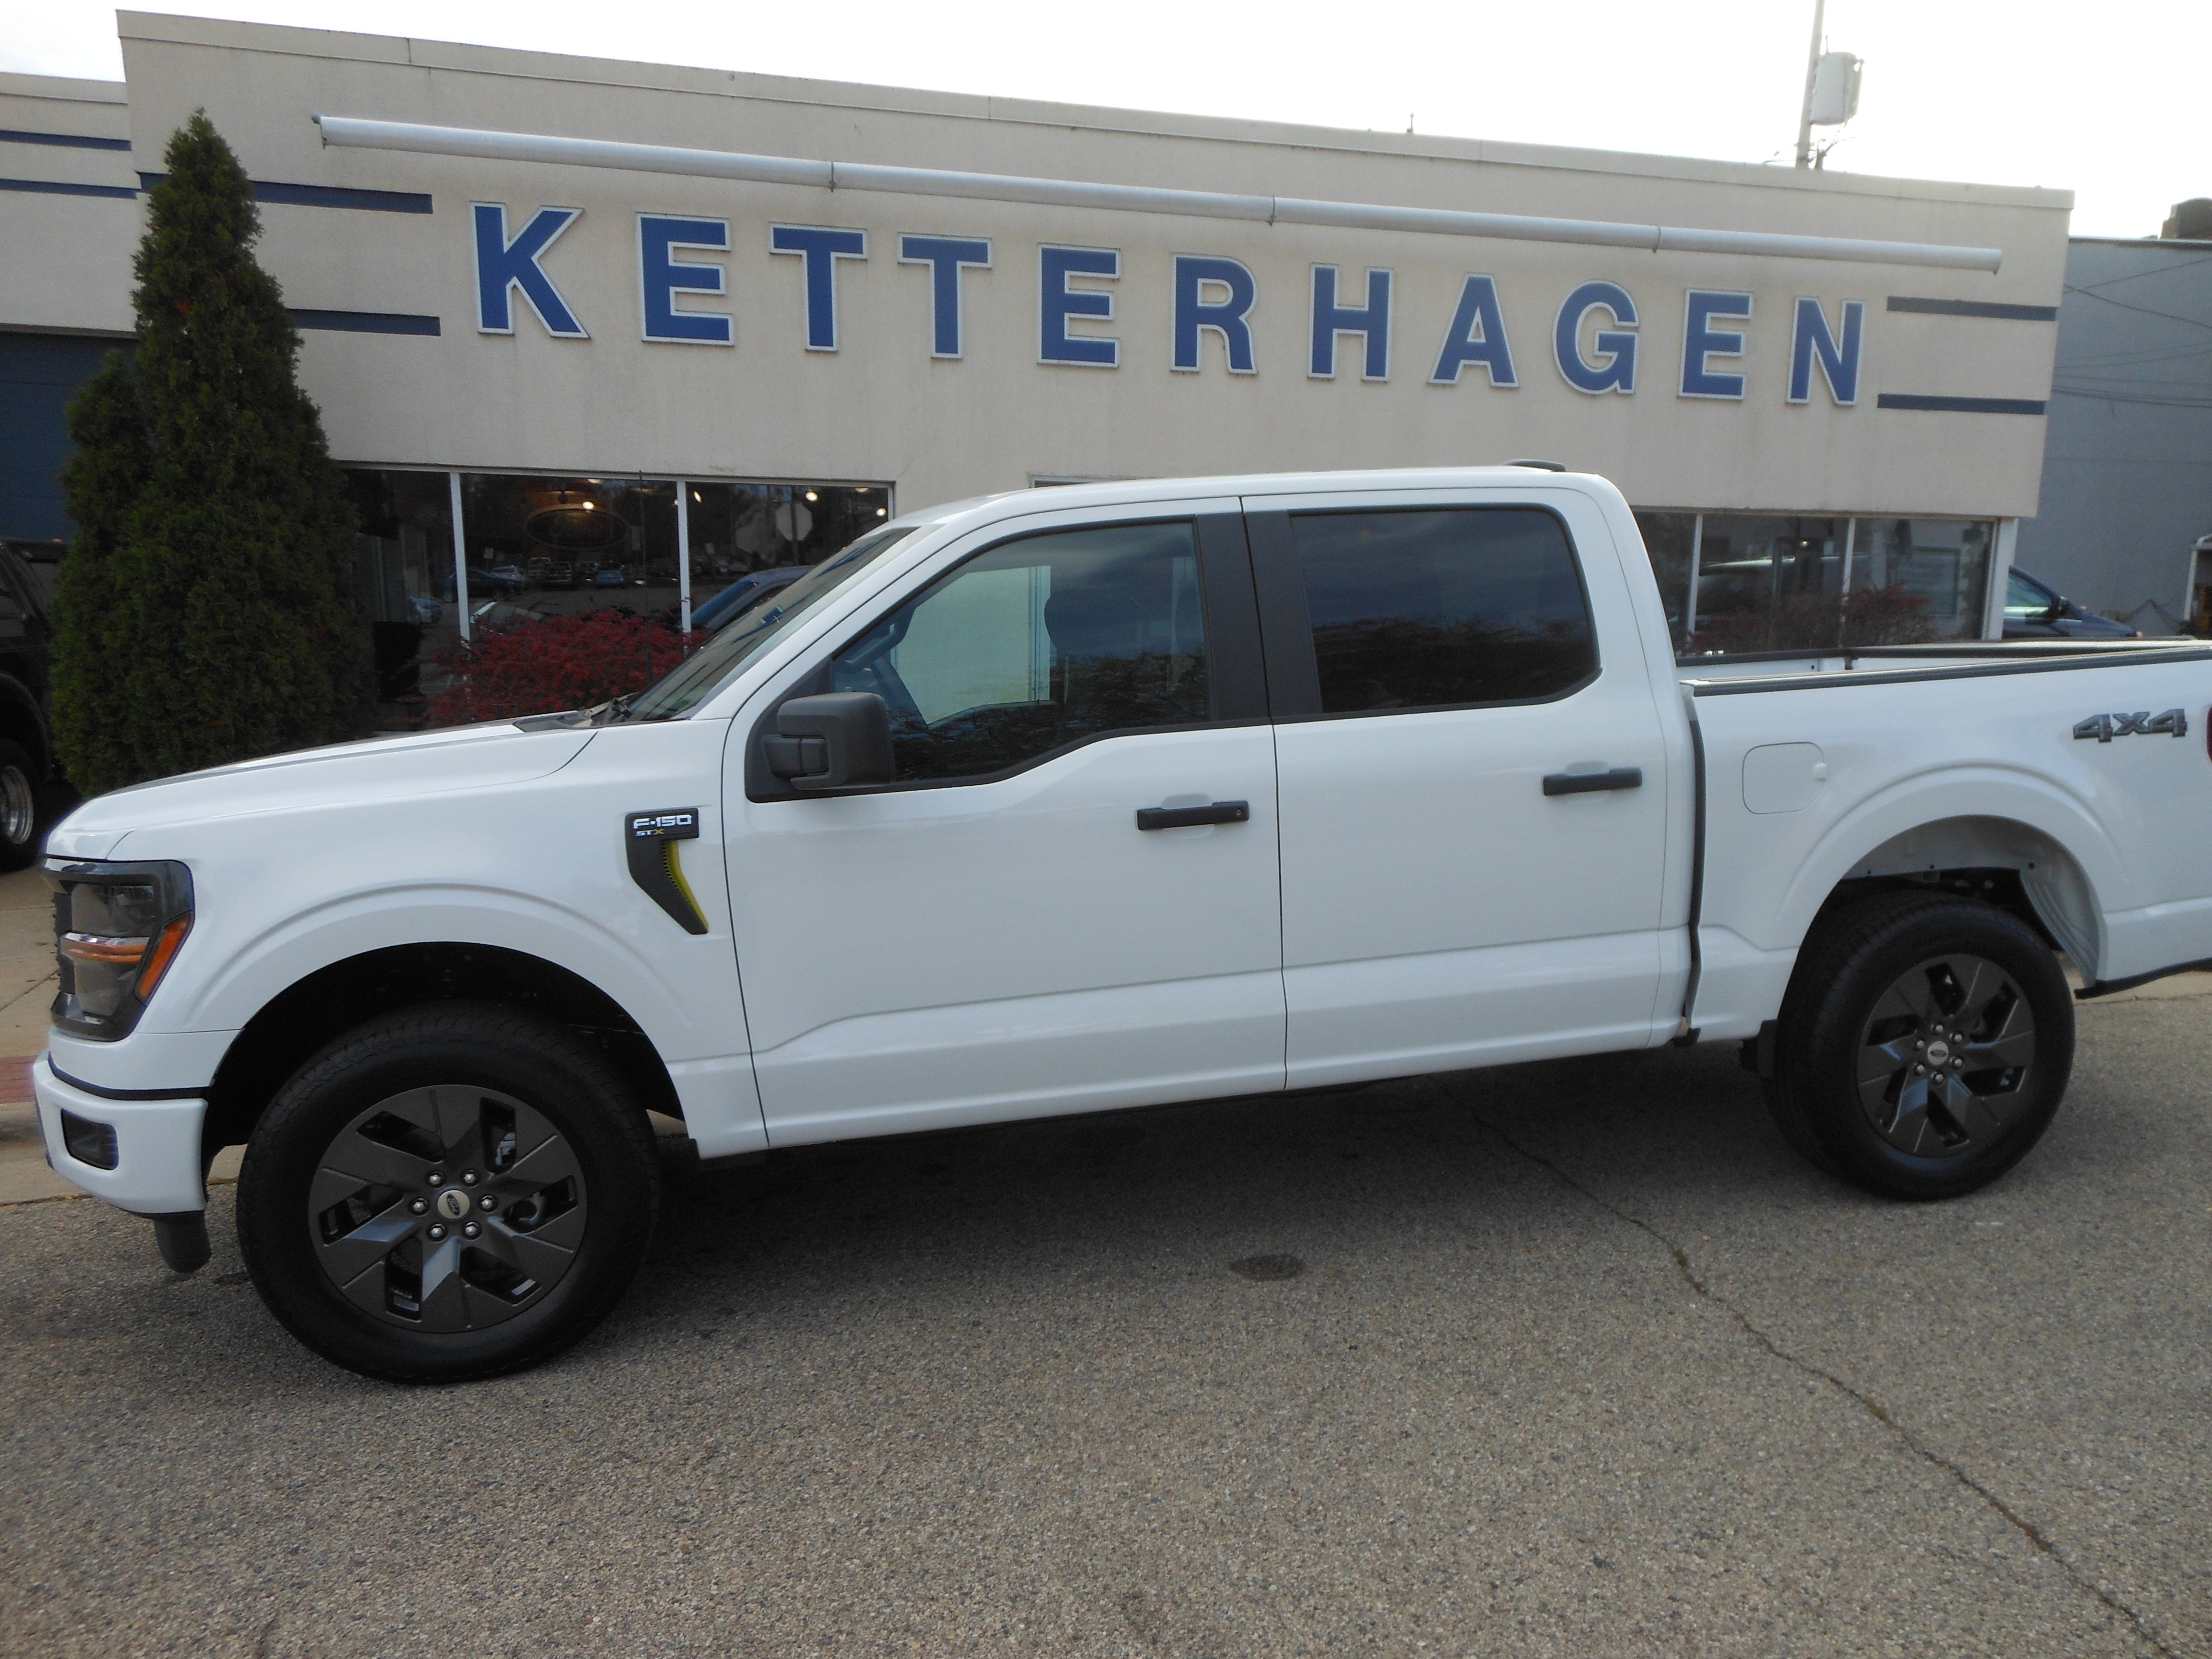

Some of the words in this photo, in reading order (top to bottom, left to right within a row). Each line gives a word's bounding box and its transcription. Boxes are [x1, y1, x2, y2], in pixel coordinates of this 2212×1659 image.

[469, 201, 1865, 405] KETTERHAGEN
[633, 814, 693, 830] F-150
[636, 829, 664, 837] STX
